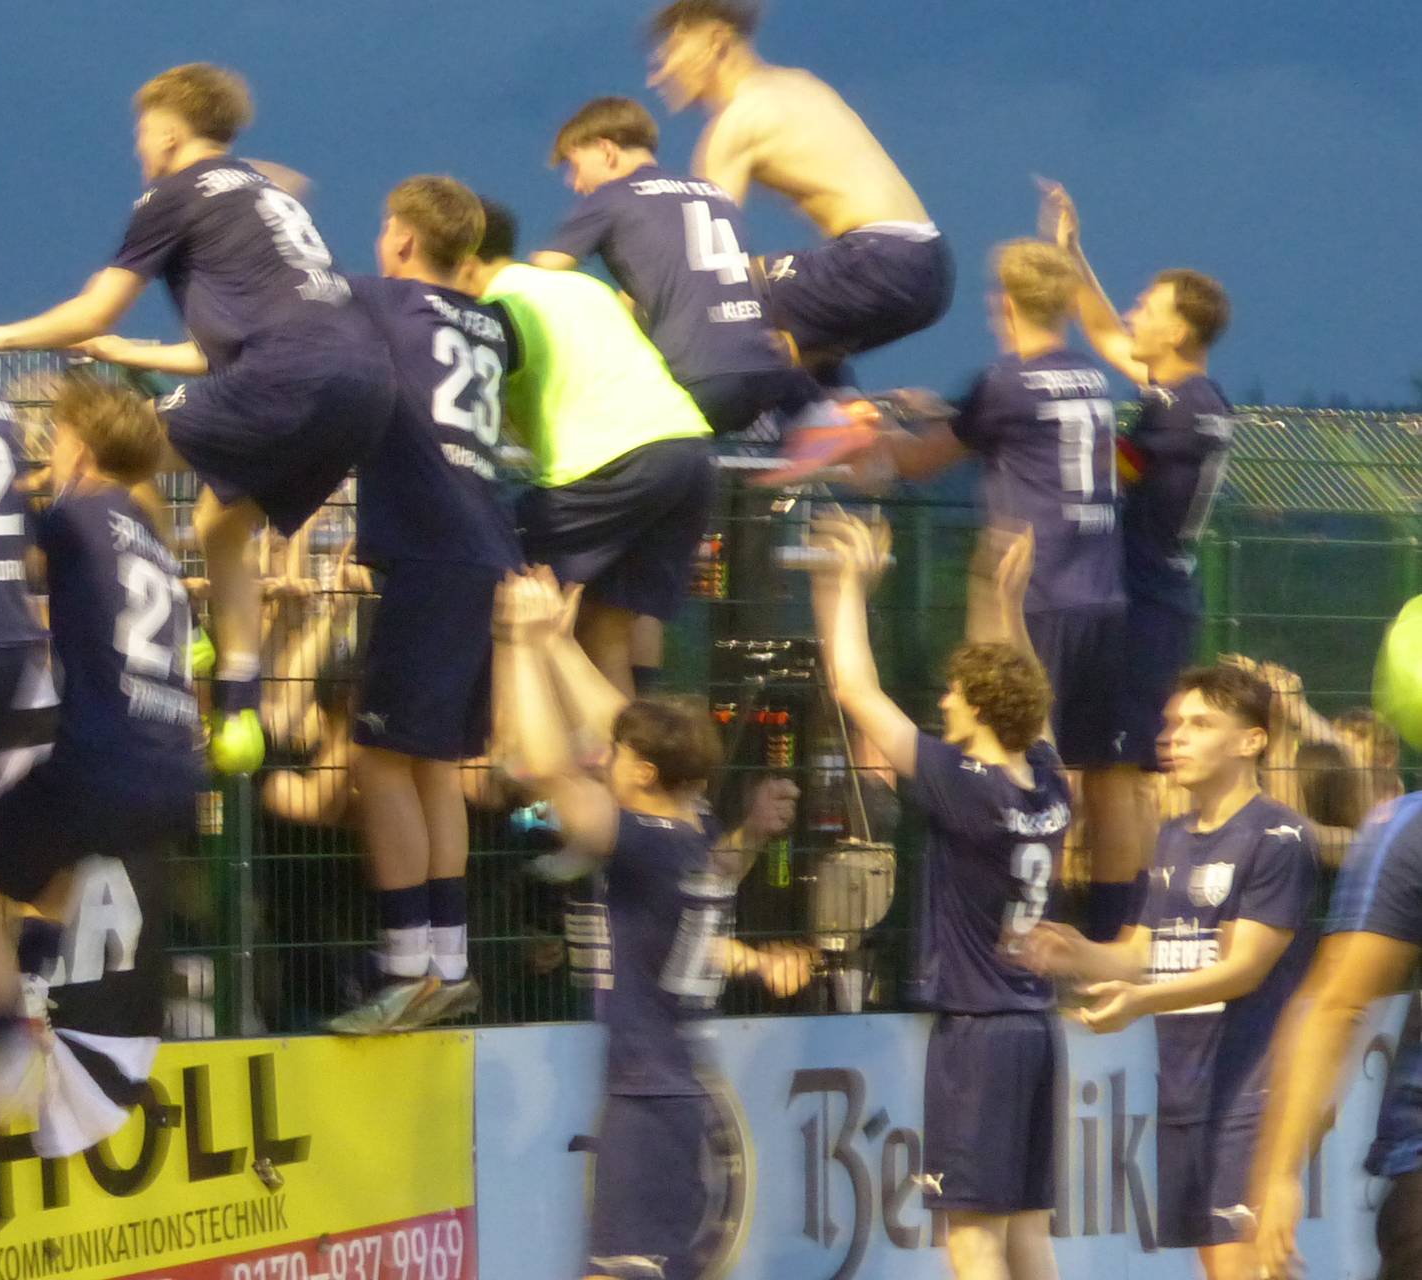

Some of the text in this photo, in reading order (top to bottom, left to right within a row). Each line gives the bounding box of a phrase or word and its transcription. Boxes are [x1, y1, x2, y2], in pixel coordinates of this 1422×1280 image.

[682, 200, 749, 285] 4
[718, 300, 762, 321] KLEES
[432, 327, 503, 446] 23
[1153, 940, 1219, 970] REWE
[392, 1219, 464, 1280] 9969
